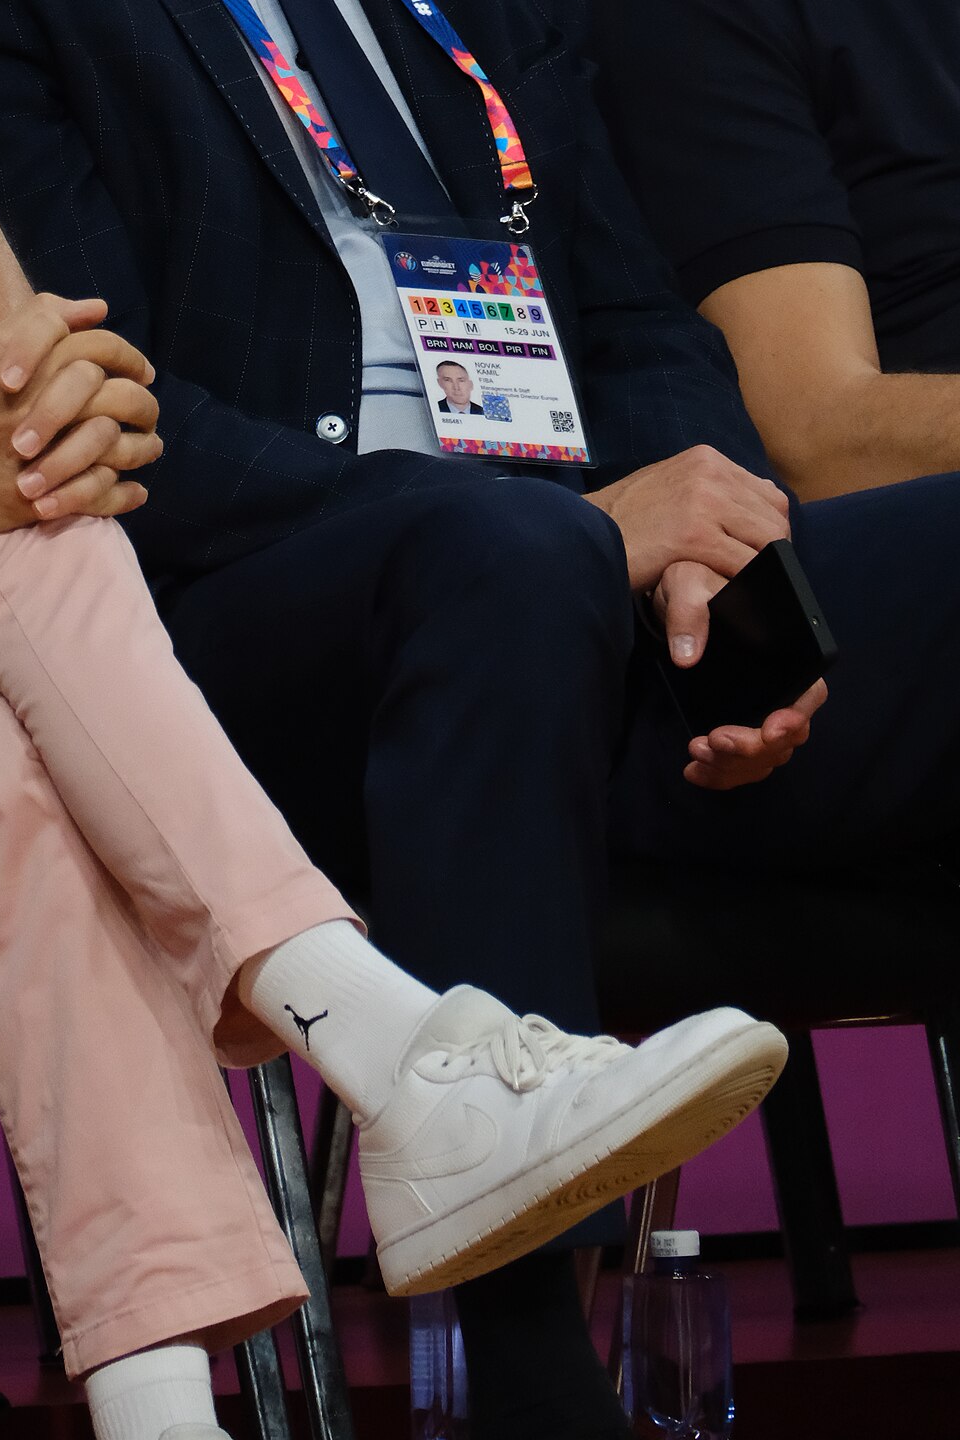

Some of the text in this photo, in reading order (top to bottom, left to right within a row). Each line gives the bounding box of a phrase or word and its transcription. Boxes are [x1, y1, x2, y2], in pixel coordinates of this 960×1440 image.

[414, 300, 541, 320] 1 2 3 4 5 6 7 8 9
[418, 319, 478, 334] P H M
[504, 327, 550, 338] 15-29 JUN
[426, 339, 448, 348] BRN
[452, 341, 474, 350] HAM
[478, 342, 499, 352] BOL
[506, 345, 523, 354] PIR
[532, 347, 549, 356] FIN
[476, 368, 500, 376] KAMIL
